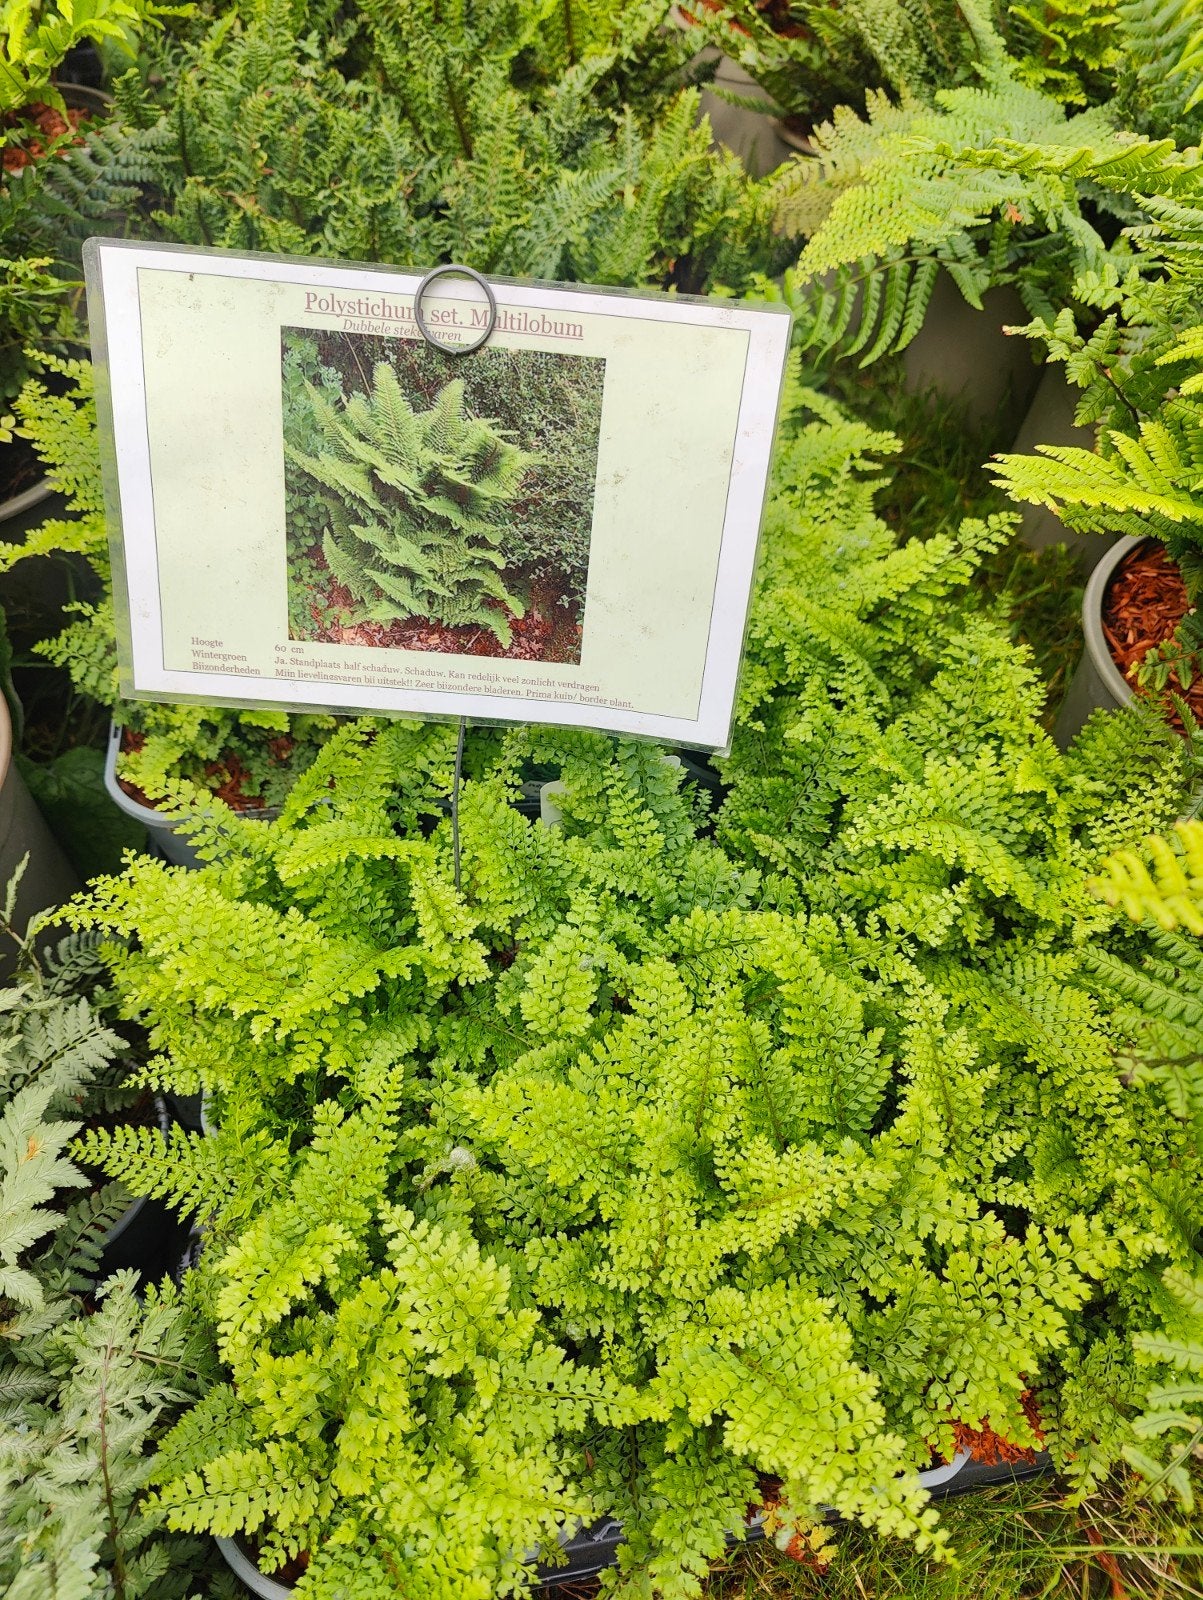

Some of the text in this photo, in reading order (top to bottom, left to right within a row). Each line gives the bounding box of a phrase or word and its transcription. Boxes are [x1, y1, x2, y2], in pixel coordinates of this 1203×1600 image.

[430, 307, 463, 326] set.
[343, 319, 391, 334] Dubbele
[191, 637, 304, 654] Hoogte 60 cm
[192, 649, 600, 692] Wintergroen Ja. Standplaats half schaduw. Schaduw. Kan redelijk veel zonlicht verdragen
[377, 676, 413, 687] uitstek!!
[415, 680, 434, 689] Zeer
[484, 685, 523, 696] bladeren.
[526, 689, 552, 699] Prima
[580, 693, 607, 705] border
